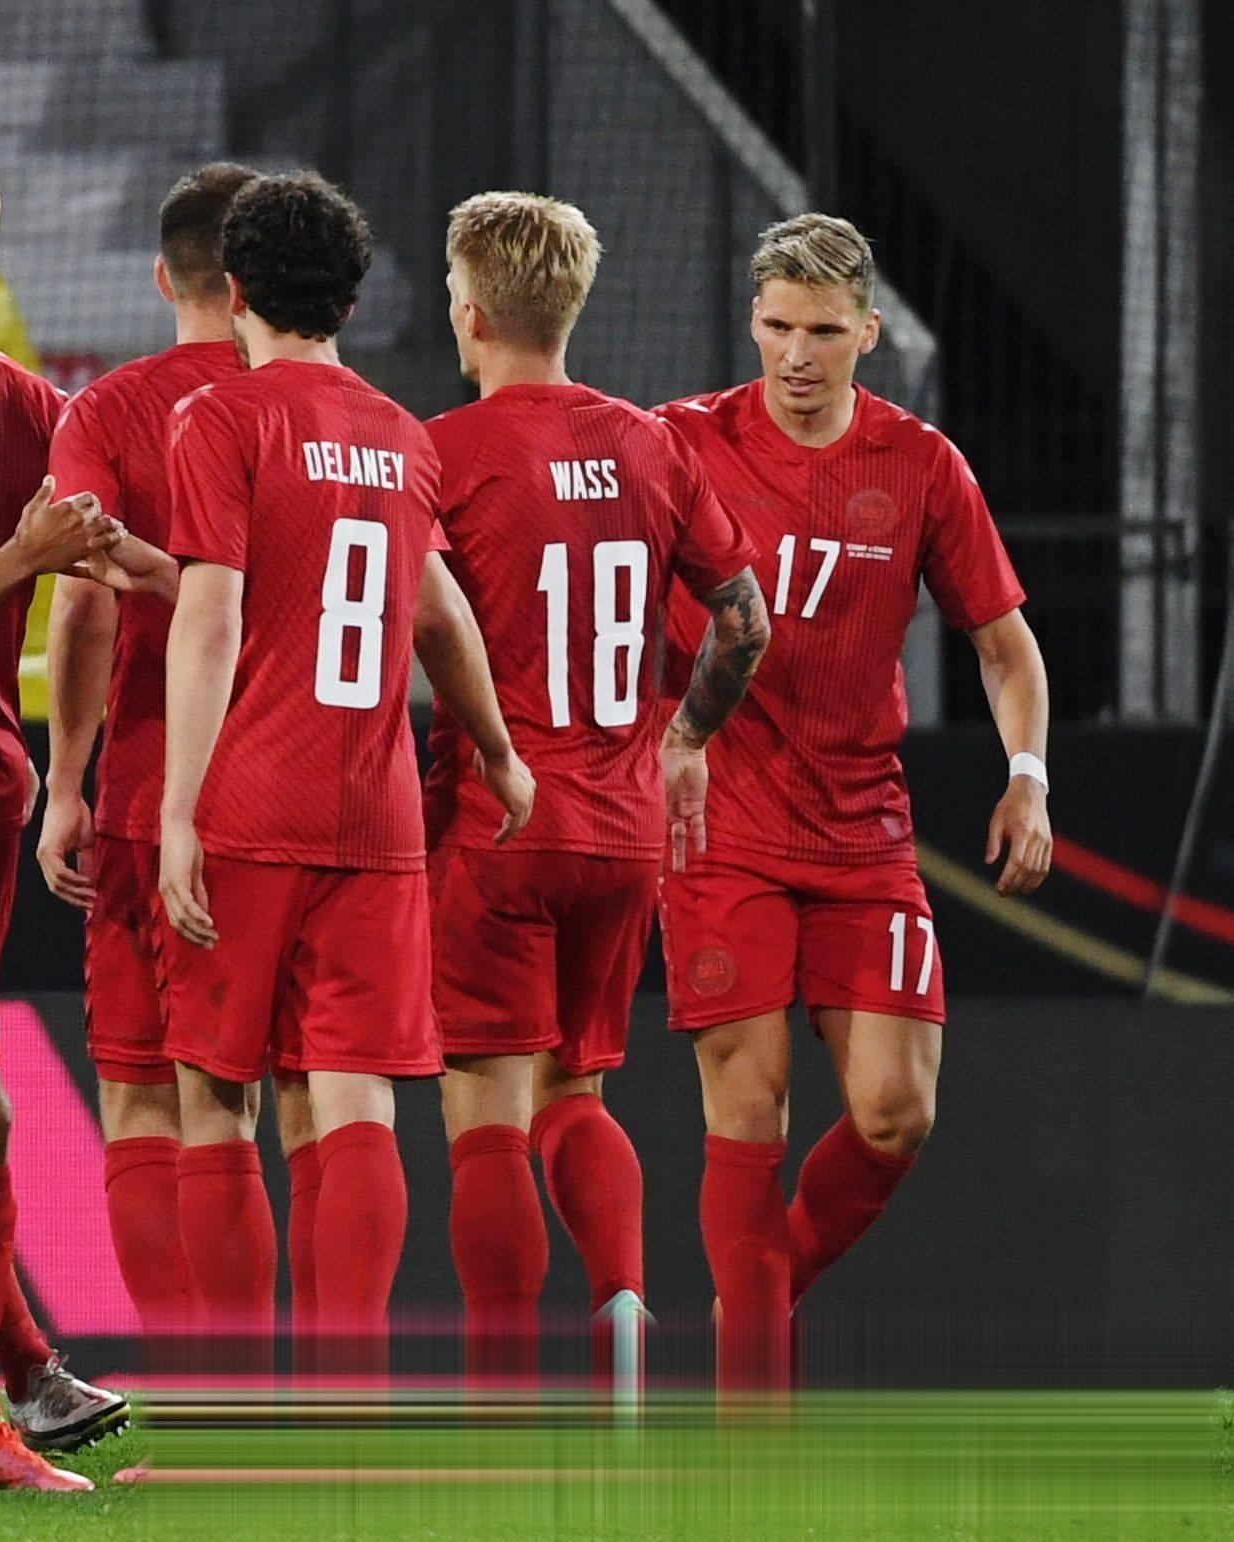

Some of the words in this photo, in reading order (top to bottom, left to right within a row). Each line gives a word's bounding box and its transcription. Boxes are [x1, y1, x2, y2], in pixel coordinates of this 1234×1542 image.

[302, 440, 405, 491] DELANEY
[549, 459, 619, 501] WASS
[314, 517, 388, 710] 8
[773, 533, 841, 619] 17
[536, 540, 649, 728] 18
[889, 912, 934, 996] 17
